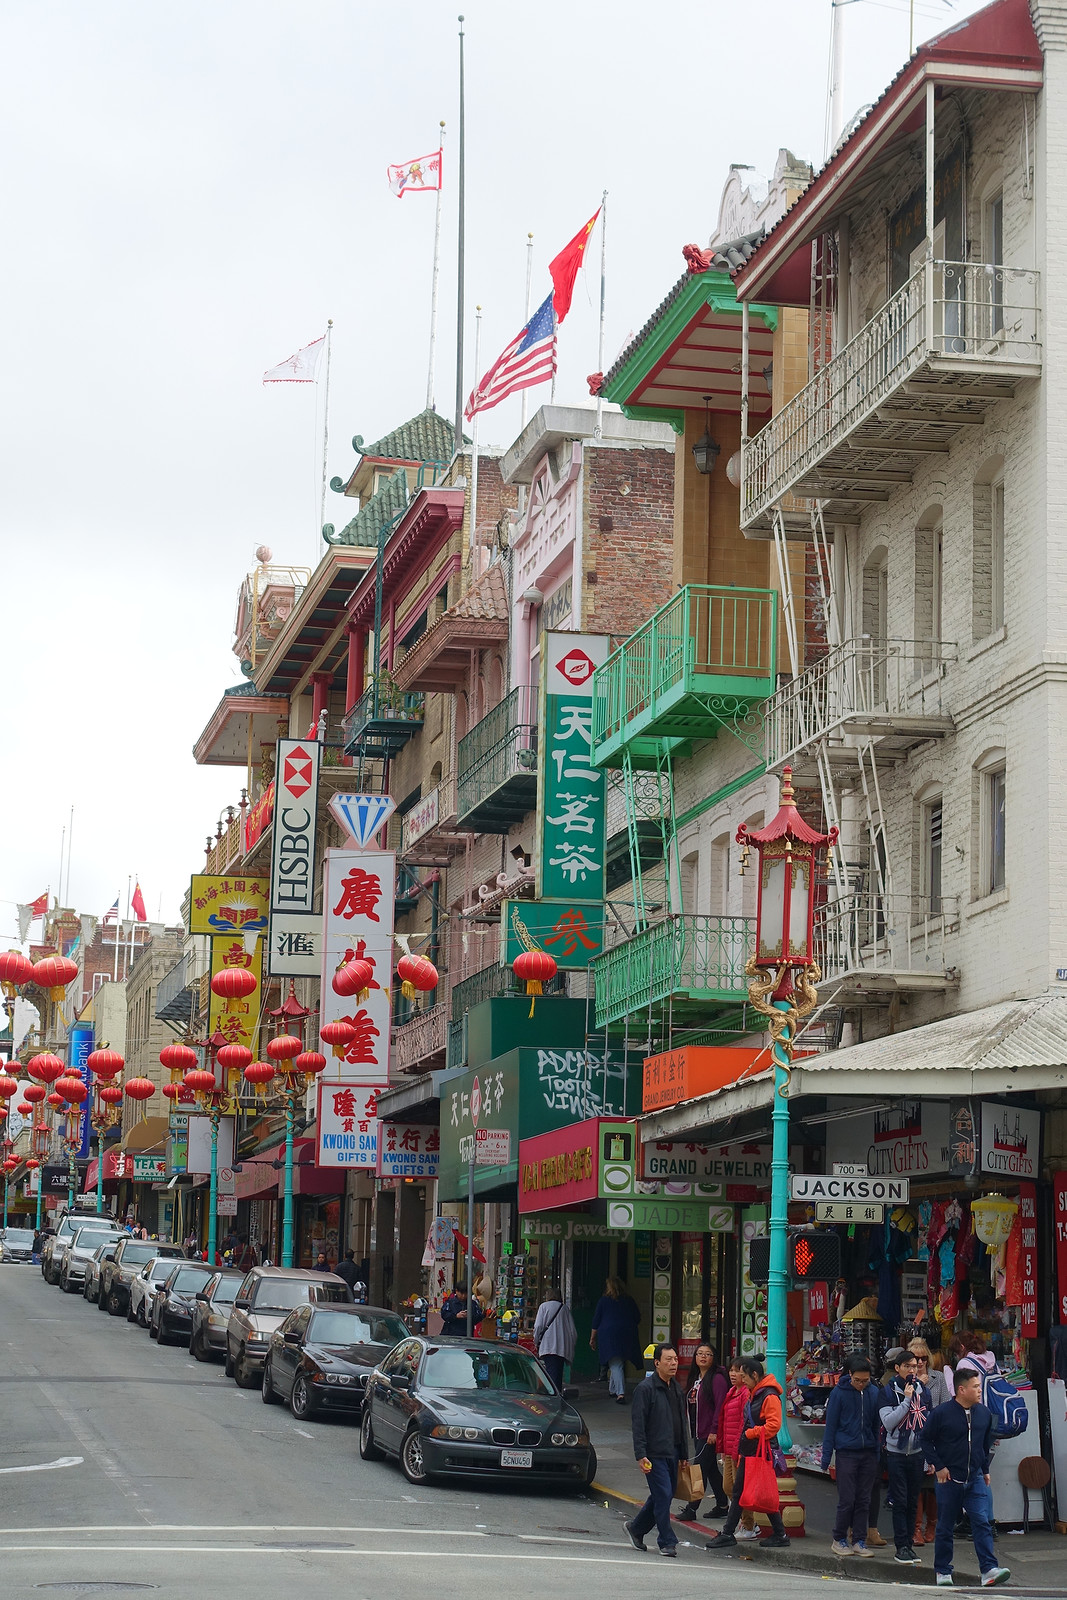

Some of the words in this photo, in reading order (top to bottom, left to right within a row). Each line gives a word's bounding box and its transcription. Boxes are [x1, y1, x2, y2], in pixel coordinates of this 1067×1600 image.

[546, 706, 601, 883] 天仁茗茶
[277, 808, 311, 906] HSBC
[323, 1133, 356, 1150] KWONG
[477, 1130, 486, 1140] NO
[487, 1132, 509, 1140] PARKING
[134, 1160, 155, 1170] TEA
[337, 1152, 367, 1163] GIFTS
[370, 1153, 377, 1163] &
[383, 1153, 416, 1164] KWONG
[418, 1154, 440, 1164] SAN
[392, 1165, 423, 1175] GIFTS
[428, 1165, 436, 1175] &
[650, 1157, 697, 1175] GRAND
[704, 1160, 772, 1177] JEWELRY
[838, 1165, 854, 1175] 700
[796, 1180, 902, 1199] JACKSON
[637, 1206, 694, 1227] JADE
[524, 1219, 562, 1235] Fine
[1025, 1254, 1032, 1276] 5
[1023, 1279, 1035, 1296] FOR
